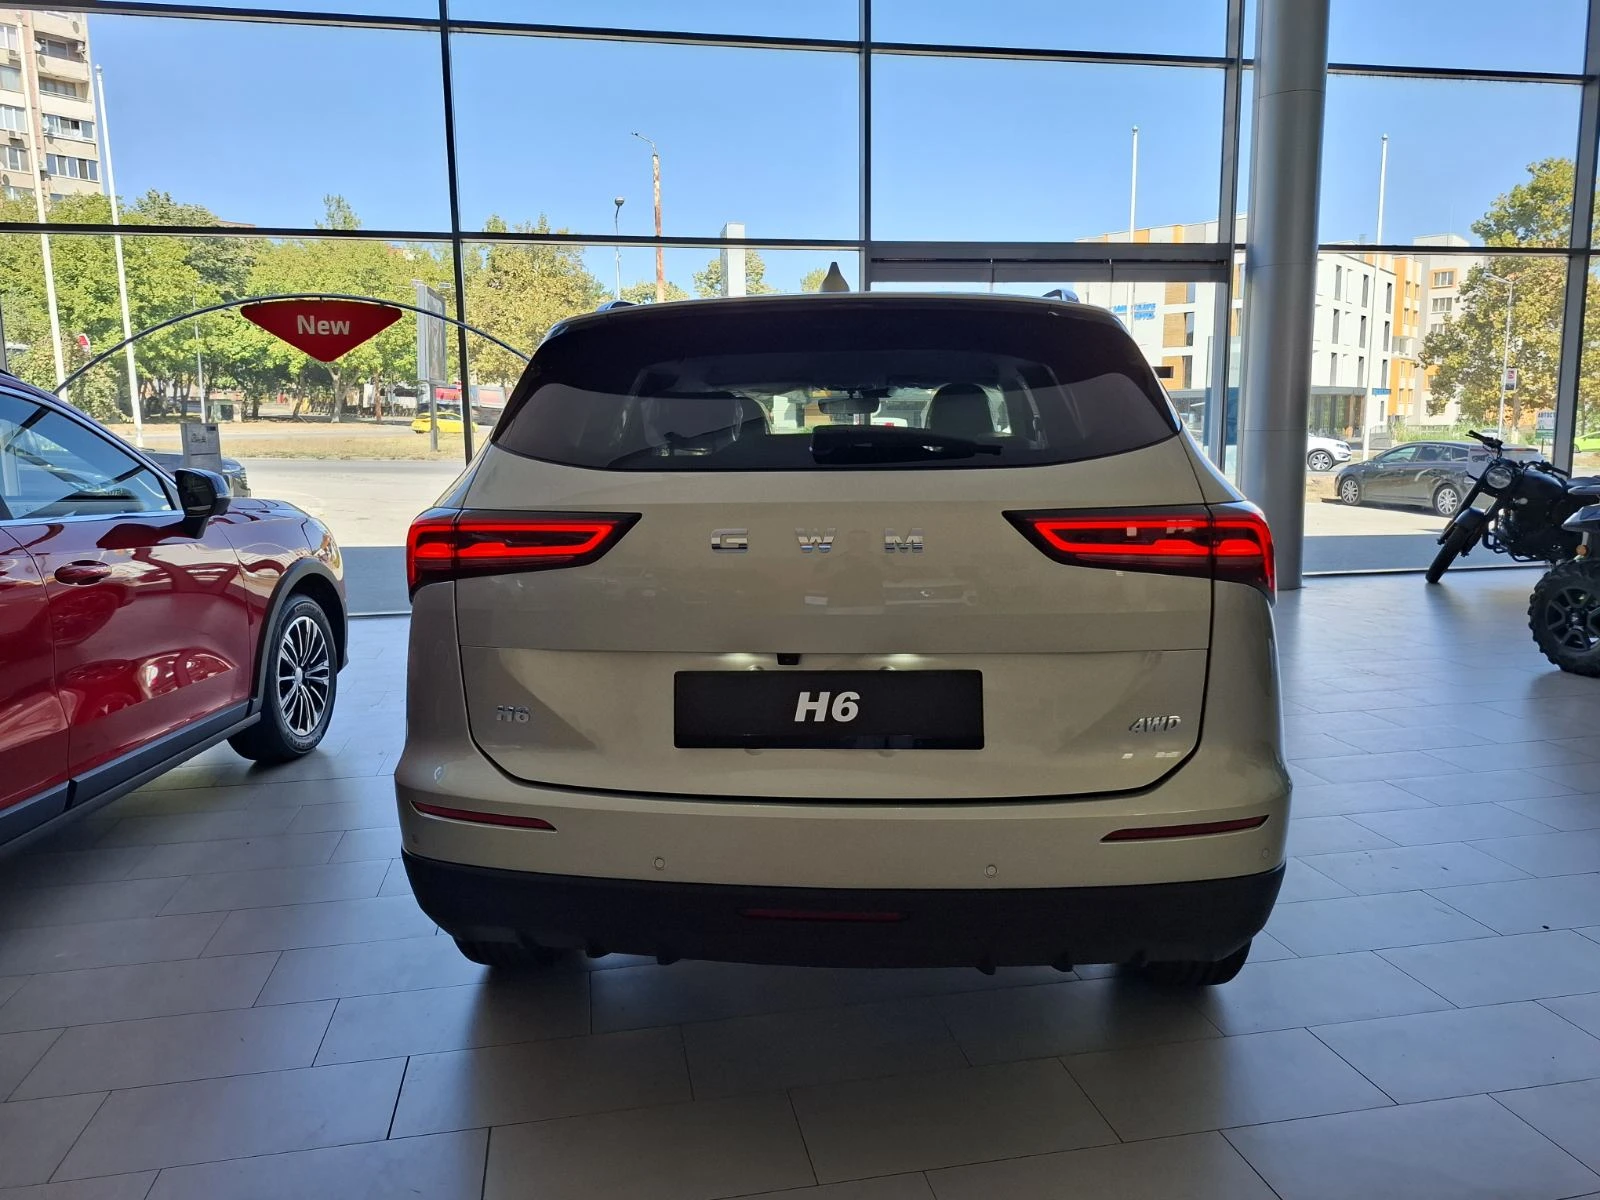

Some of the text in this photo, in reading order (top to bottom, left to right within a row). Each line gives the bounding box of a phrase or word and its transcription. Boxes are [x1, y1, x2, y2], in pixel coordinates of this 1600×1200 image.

[296, 314, 350, 335] New
[496, 705, 530, 723] H6
[793, 691, 861, 722] H6
[1128, 715, 1181, 733] 4WD
